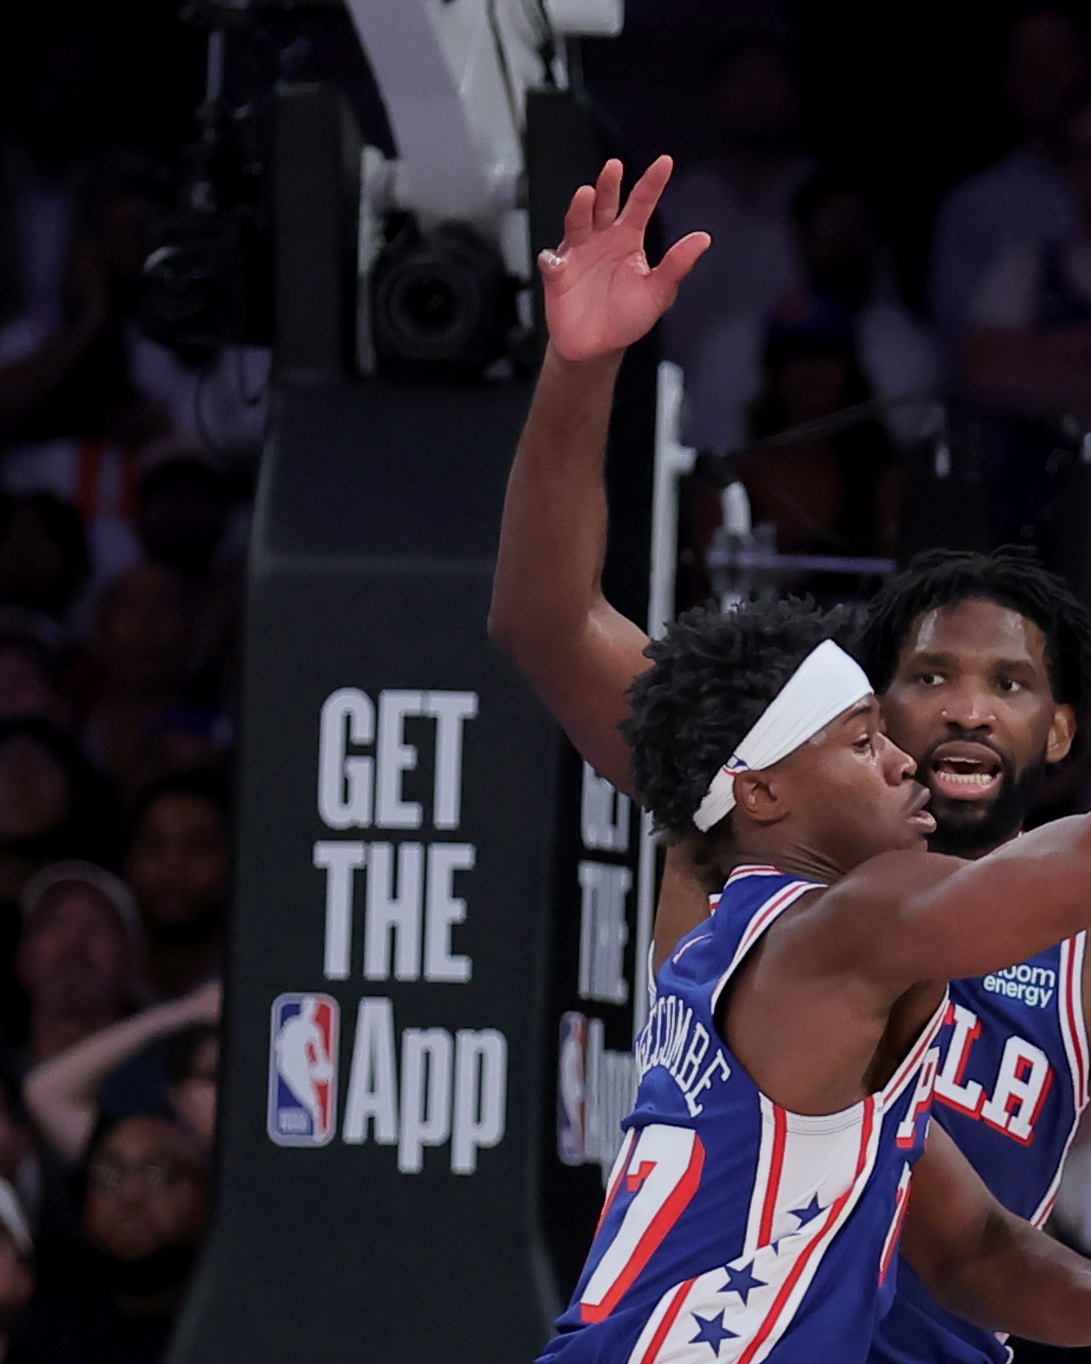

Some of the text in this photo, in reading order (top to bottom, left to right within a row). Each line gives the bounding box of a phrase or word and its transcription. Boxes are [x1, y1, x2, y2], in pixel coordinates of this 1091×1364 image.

[317, 686, 480, 831] GET
[312, 840, 477, 984] THE
[992, 964, 1057, 988] oom
[983, 975, 1054, 1009] energy
[341, 995, 508, 1177] App
[933, 1002, 1056, 1147] LA
[573, 1123, 706, 1324] 7
